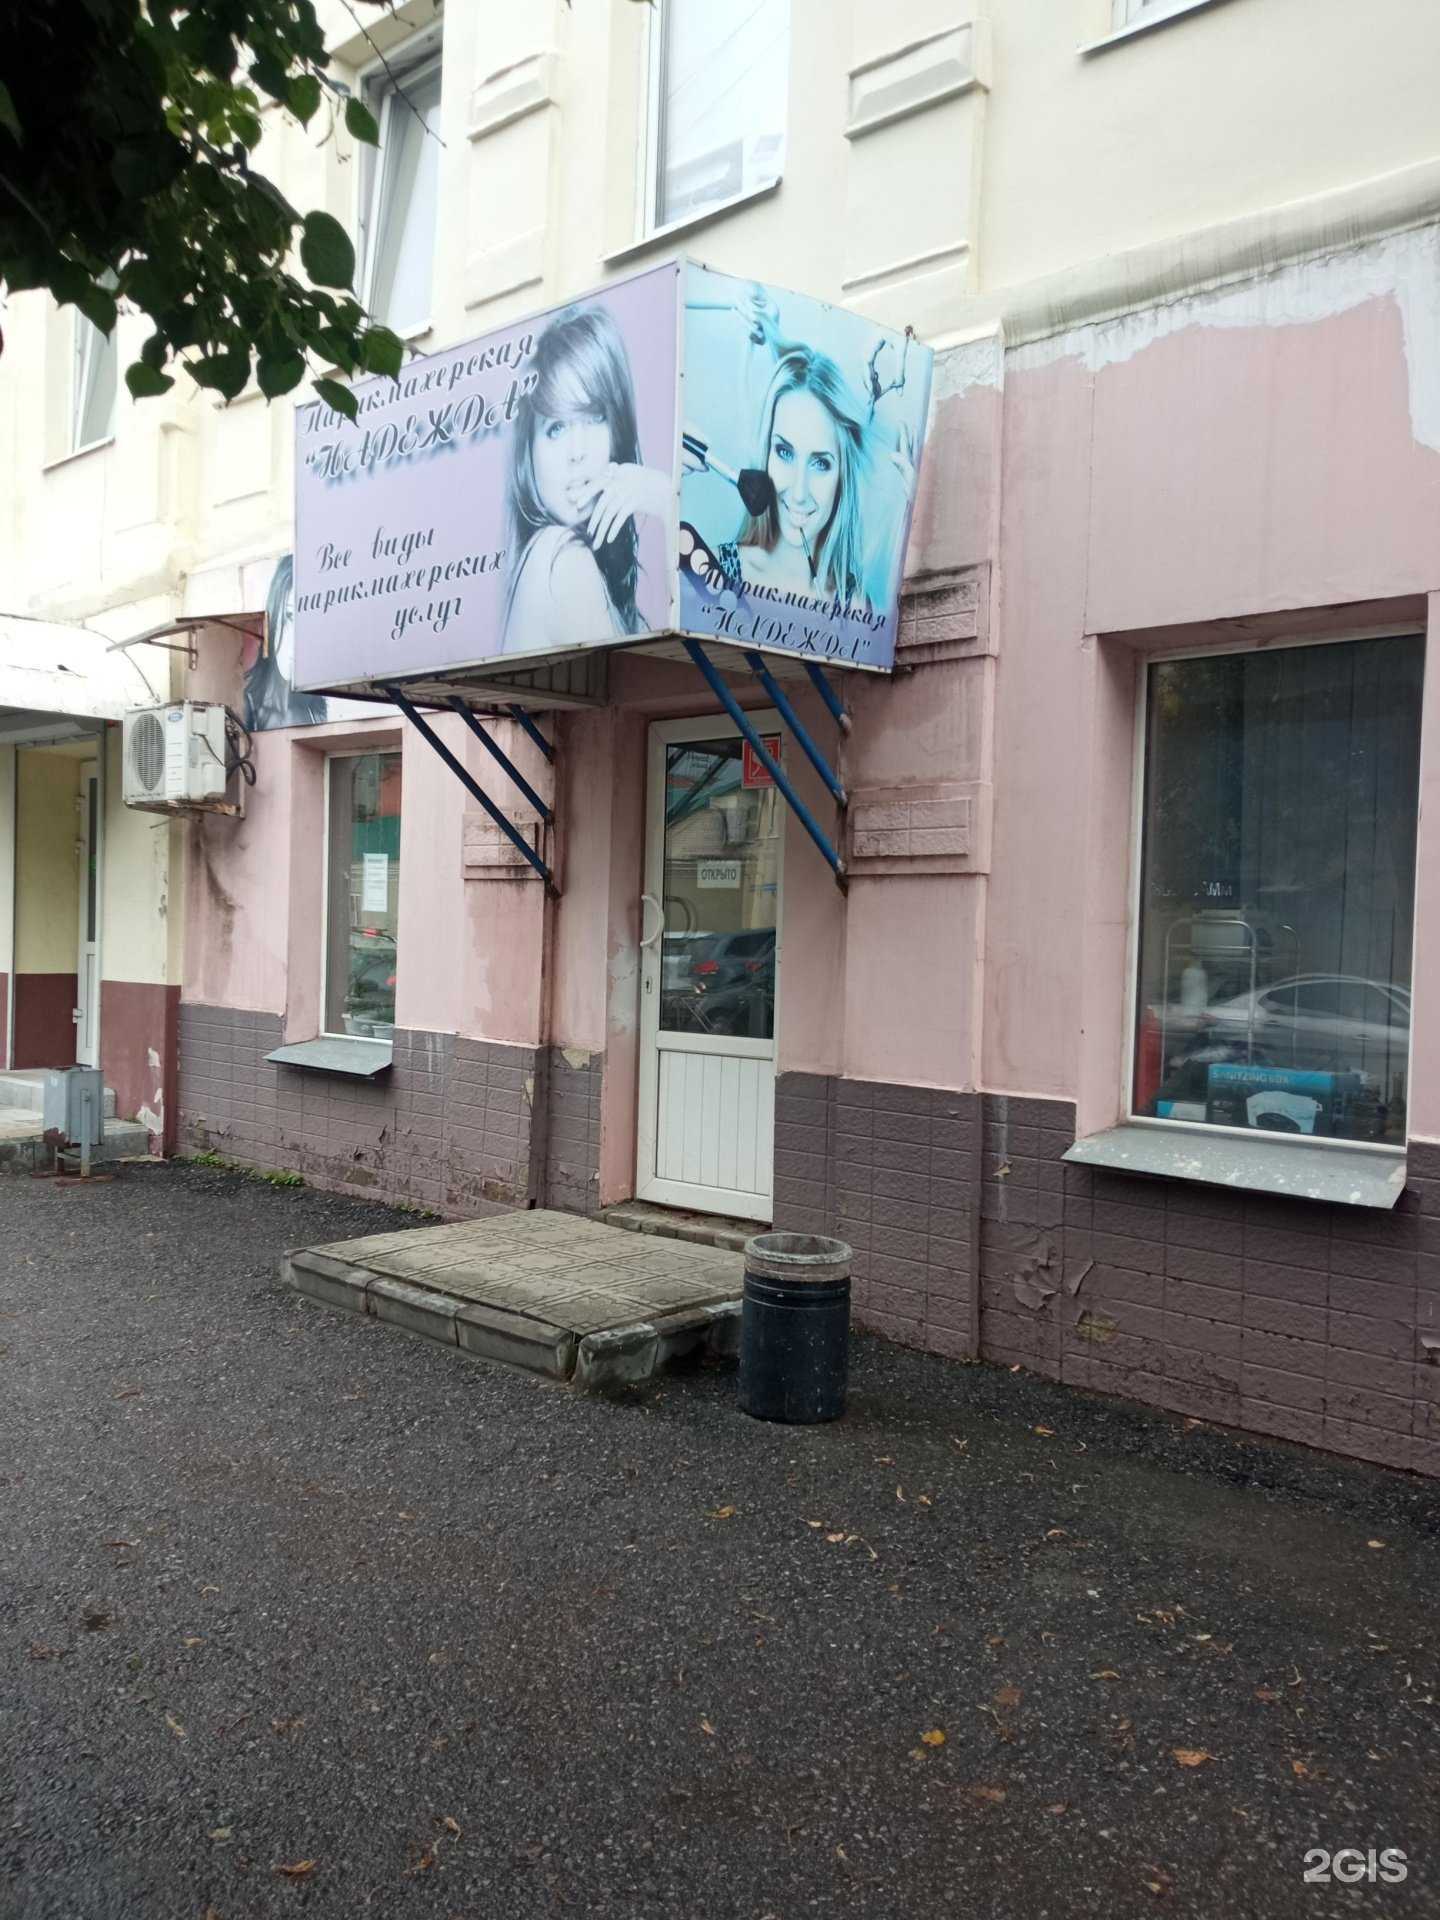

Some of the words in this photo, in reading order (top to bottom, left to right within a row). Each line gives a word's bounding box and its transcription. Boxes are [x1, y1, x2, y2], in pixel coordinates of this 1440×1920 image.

[317, 542, 352, 573] Все
[372, 526, 435, 566] виды
[297, 550, 506, 613] парикмахерских
[391, 597, 463, 640] услуг
[701, 867, 737, 881] ОТКРЫТО
